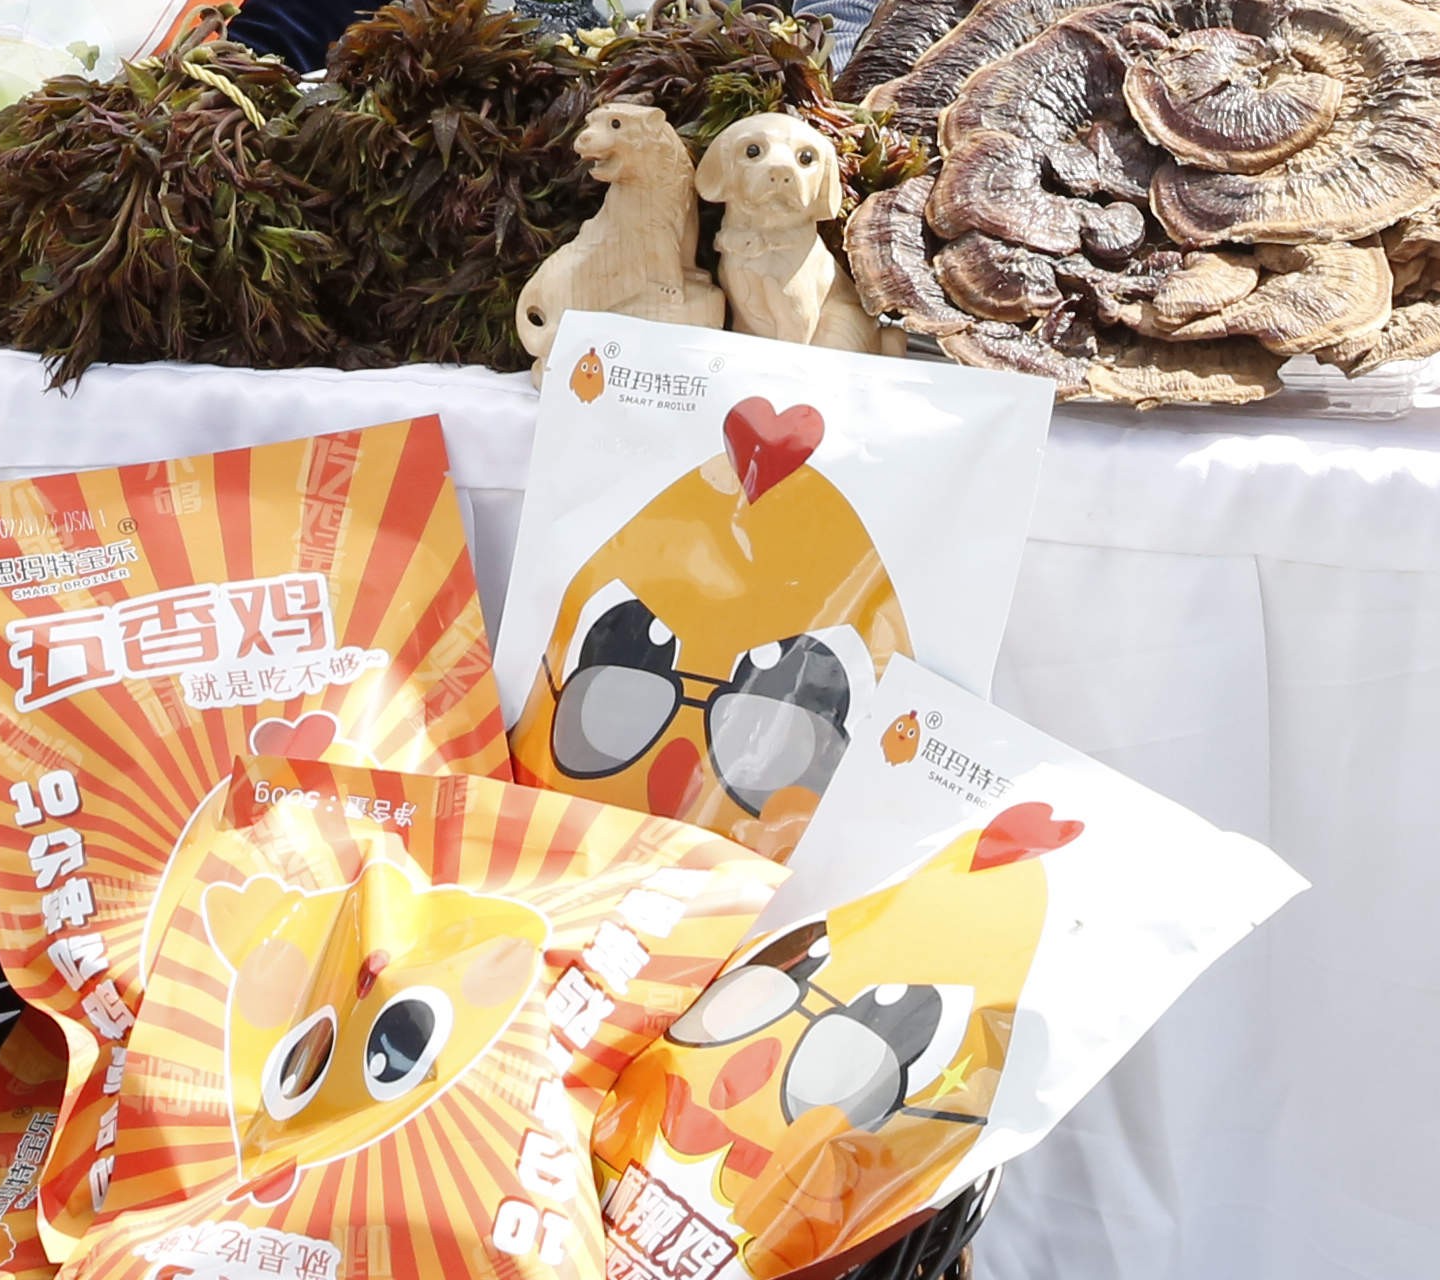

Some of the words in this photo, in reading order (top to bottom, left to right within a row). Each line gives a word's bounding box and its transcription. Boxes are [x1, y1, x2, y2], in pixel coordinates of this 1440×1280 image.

[607, 364, 710, 398] 思玛特宝乐
[617, 393, 654, 408] SMART
[656, 400, 697, 413] BROILER
[12, 582, 60, 601] SMART
[63, 568, 131, 593] BROILER
[12, 576, 329, 708] 五香鸡
[927, 770, 964, 795] SMART
